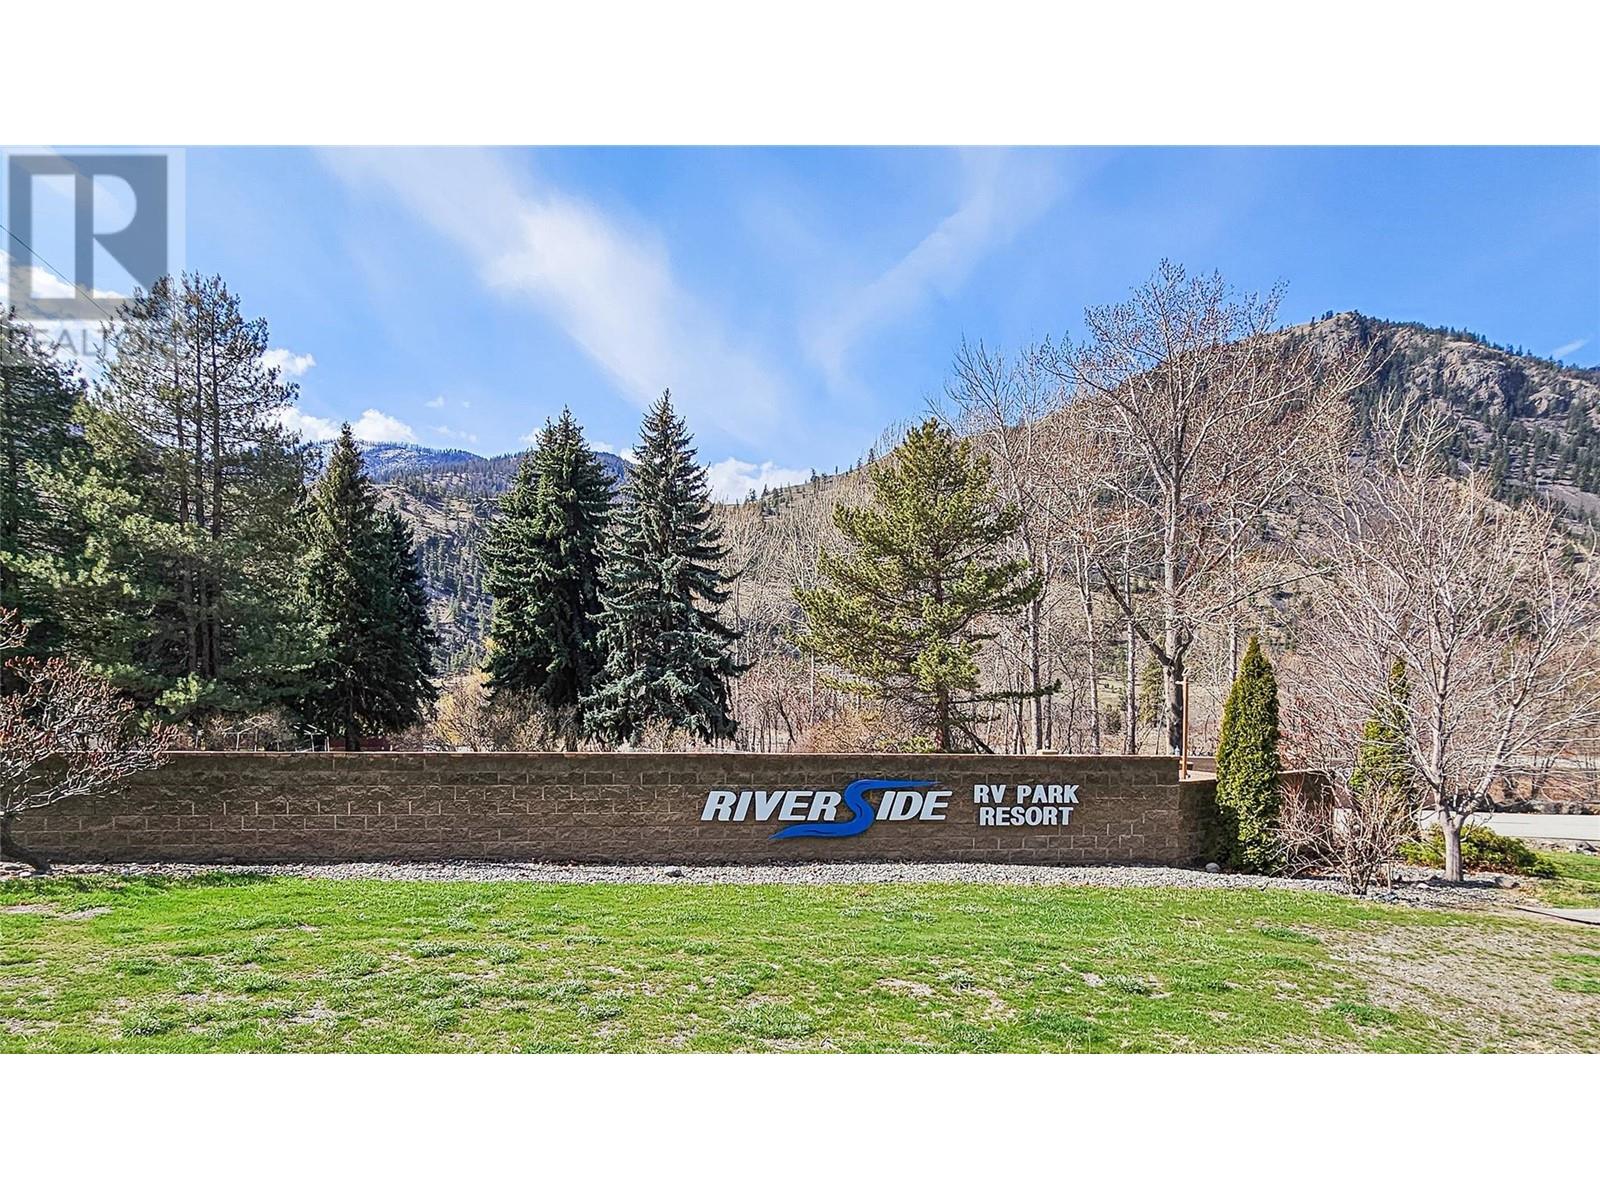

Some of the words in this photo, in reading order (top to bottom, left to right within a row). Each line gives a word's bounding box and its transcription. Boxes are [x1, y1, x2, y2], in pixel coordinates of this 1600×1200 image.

[973, 784, 1007, 804] RV
[1017, 784, 1080, 804] PARK
[702, 779, 952, 839] RIVERSIDE
[979, 806, 1074, 826] RESORT
